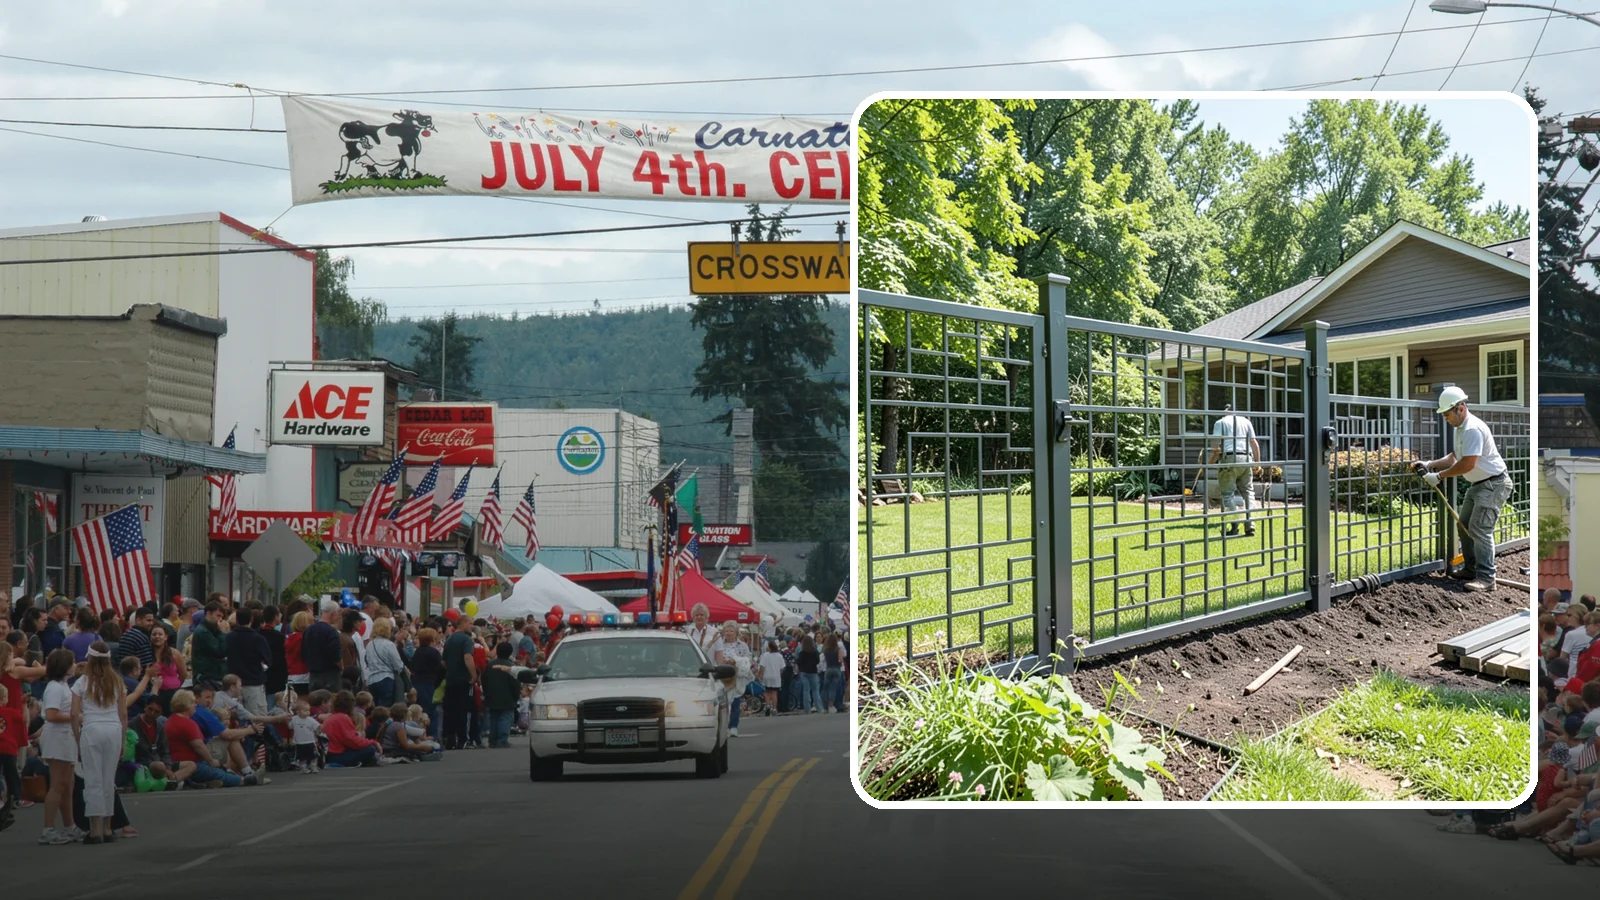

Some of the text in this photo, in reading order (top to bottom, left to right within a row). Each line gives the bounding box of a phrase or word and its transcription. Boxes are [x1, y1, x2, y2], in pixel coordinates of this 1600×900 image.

[695, 121, 850, 149] Carnat
[481, 141, 604, 191] JULY
[632, 150, 746, 198] 4th.
[697, 254, 850, 280] CROSSWA
[283, 380, 373, 420] ACE
[406, 409, 452, 422] CEDAR
[283, 421, 371, 436] Hardware
[416, 428, 477, 447] Coca-Cola
[95, 485, 124, 495] Vincent
[126, 486, 136, 495] de
[137, 486, 155, 495] Paul
[688, 526, 741, 535] CRNATION
[699, 535, 730, 543] GLASS
